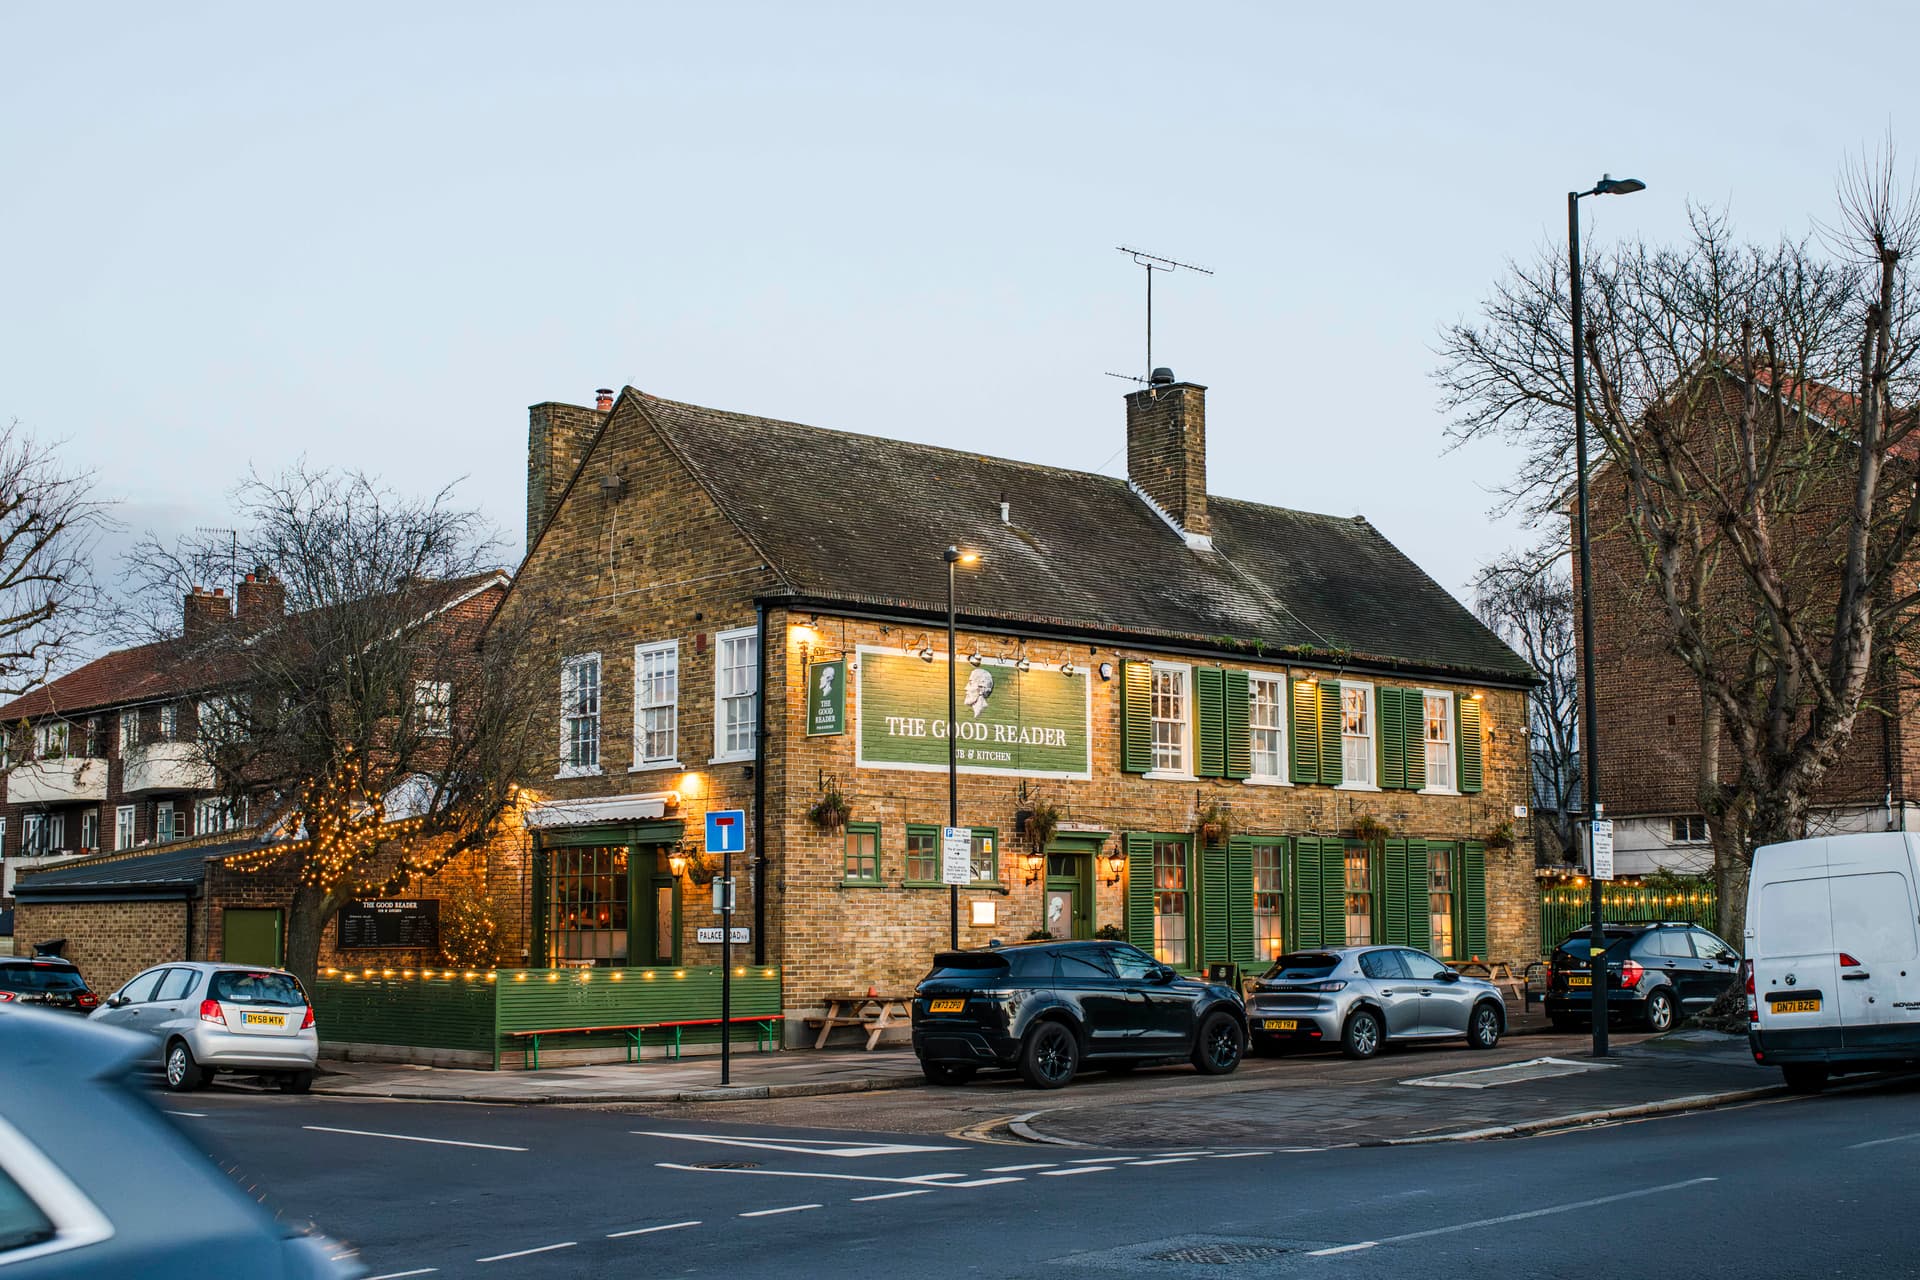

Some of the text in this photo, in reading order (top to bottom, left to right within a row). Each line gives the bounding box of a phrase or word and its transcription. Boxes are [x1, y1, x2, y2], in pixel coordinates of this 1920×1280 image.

[815, 715, 836, 723] READER
[885, 716, 926, 737] THE
[994, 724, 1067, 746] READER
[977, 750, 1011, 761] KITCHEN
[700, 931, 722, 940] PALACE
[1777, 1000, 1815, 1012] DN71 BZE
[247, 1015, 267, 1023] DY58
